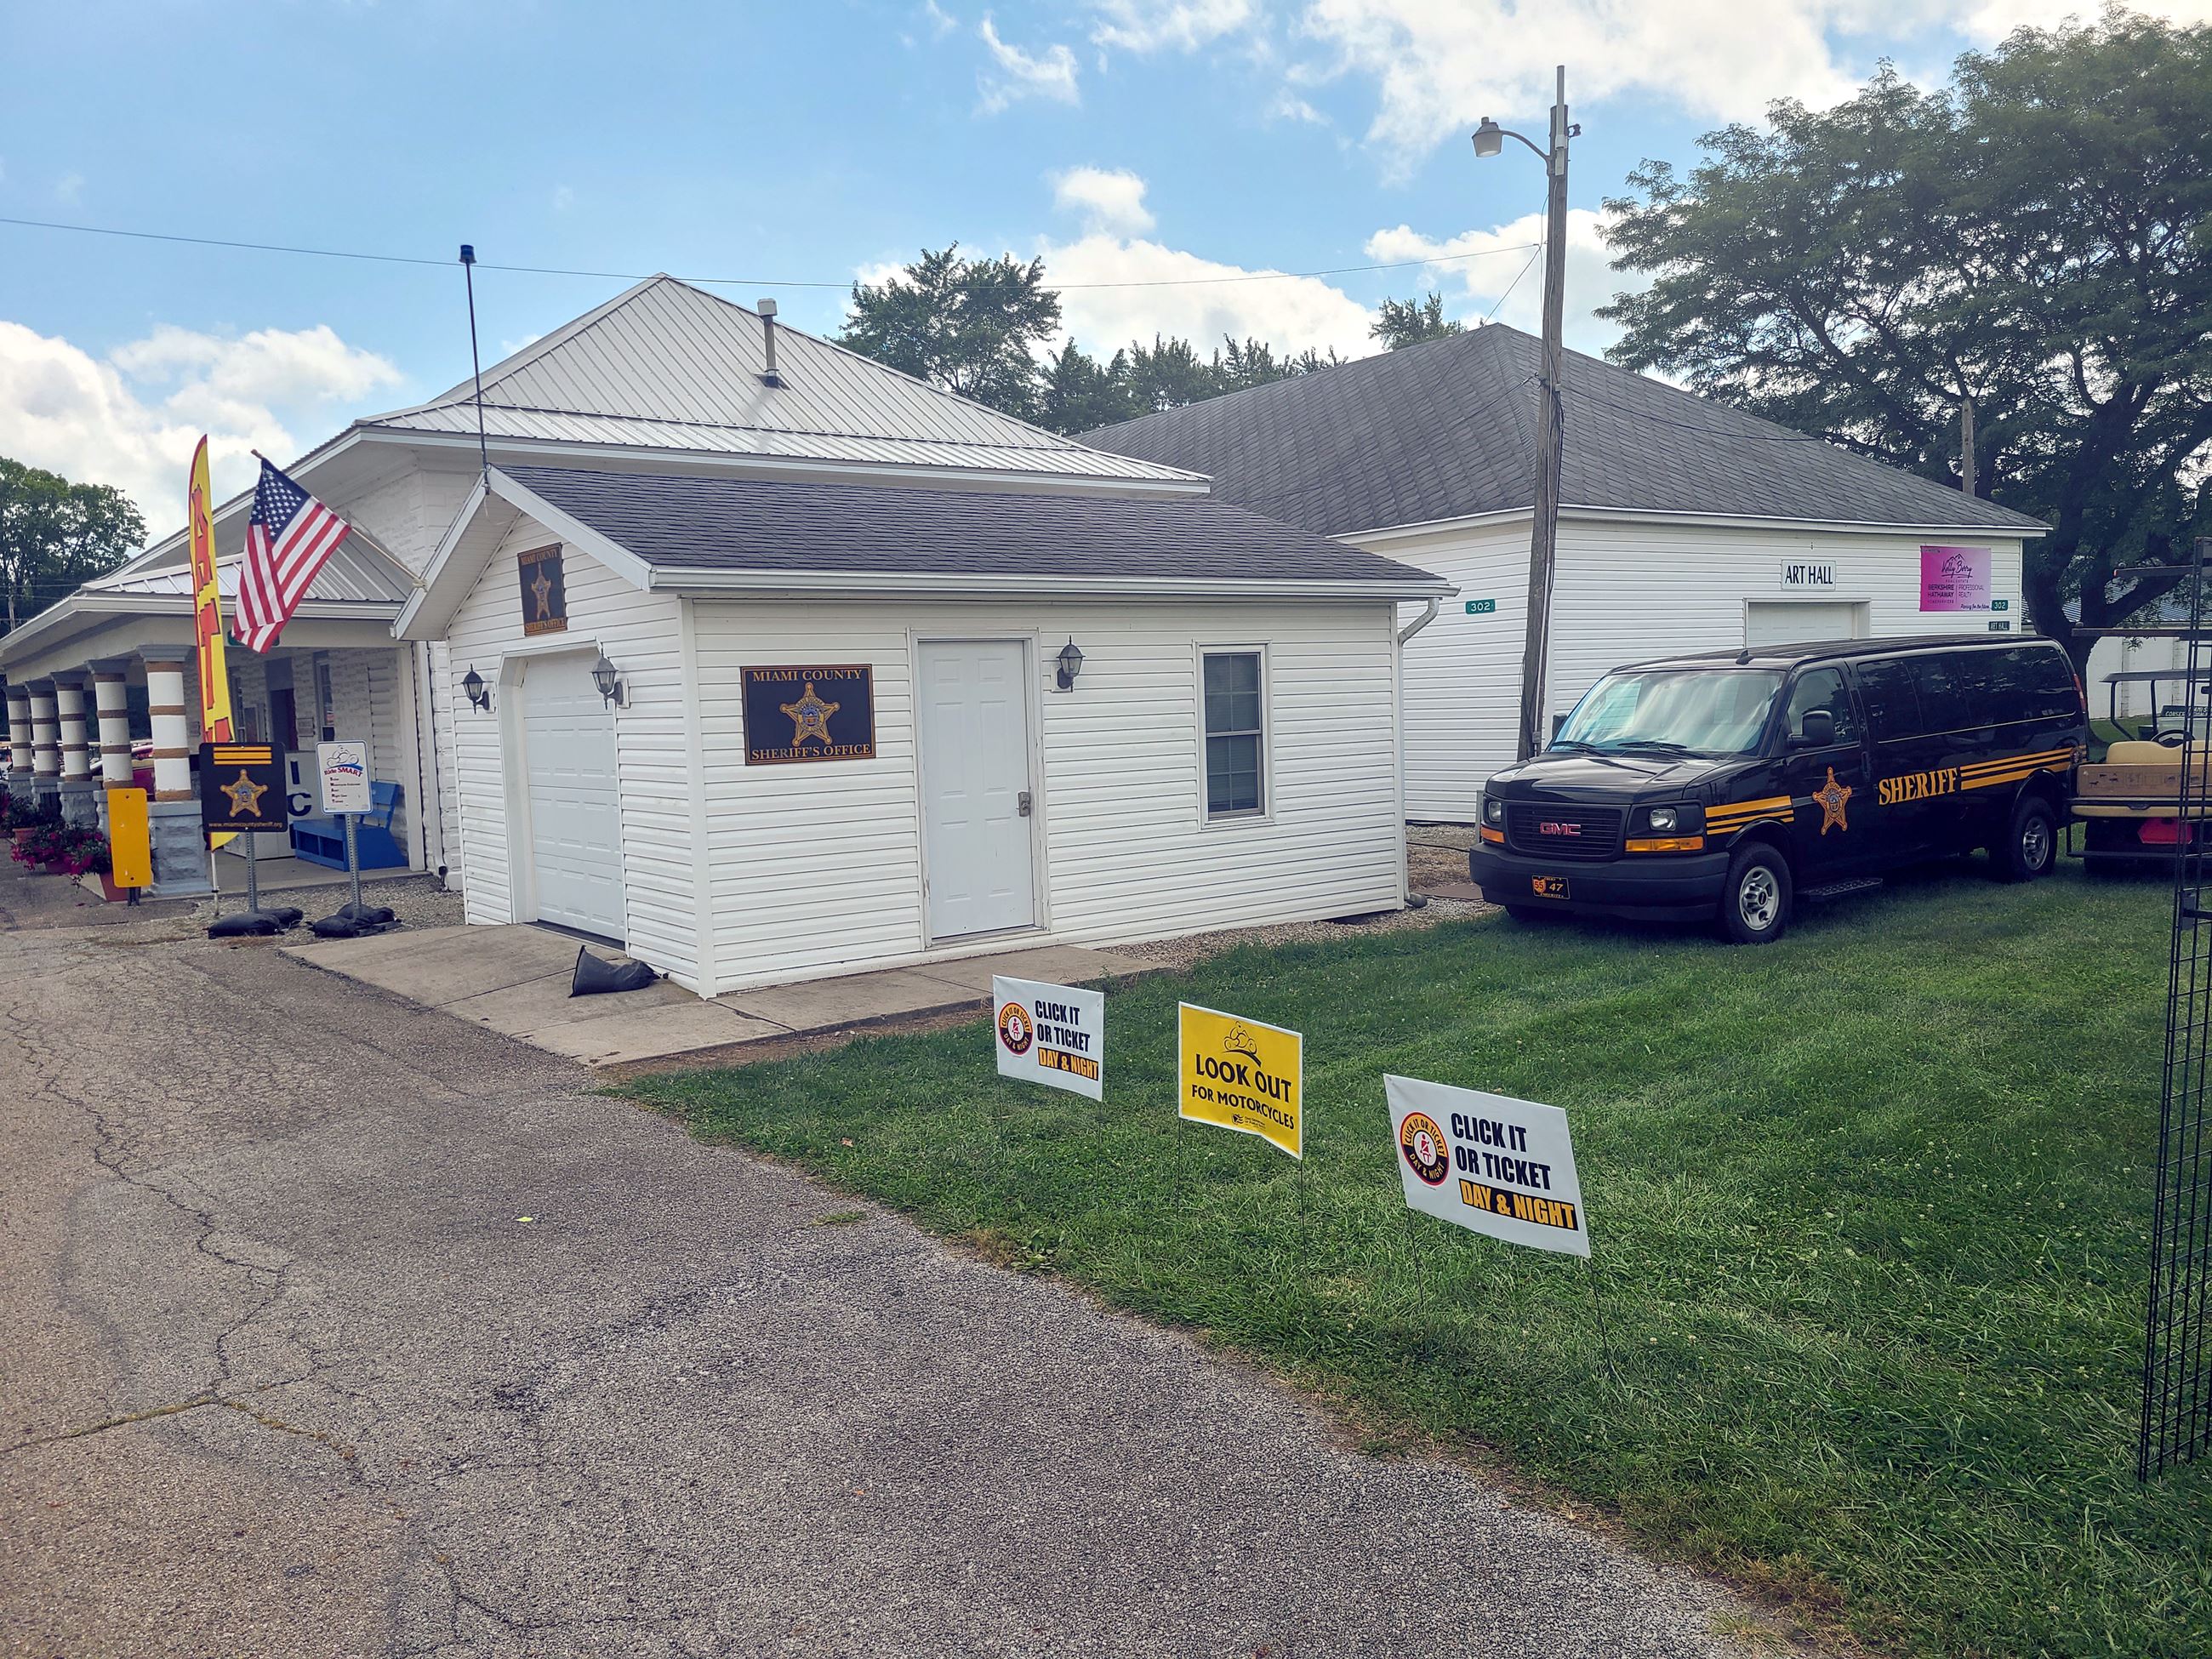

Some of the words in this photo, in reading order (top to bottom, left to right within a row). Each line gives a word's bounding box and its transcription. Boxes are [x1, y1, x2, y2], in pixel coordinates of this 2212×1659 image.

[537, 549, 557, 562] COUNTY
[1785, 565, 1805, 584] ART
[1808, 566, 1833, 584] HALL
[1470, 601, 1491, 612] 302
[1994, 601, 2006, 610] 302
[753, 671, 797, 681] MIAMI
[802, 670, 863, 681] COUNTY
[751, 746, 820, 761] SHERIFF'S
[824, 744, 871, 756] OFFICE
[338, 767, 363, 778] SMART
[1878, 767, 1958, 806] SHERIFF
[1540, 822, 1581, 836] GMC
[1534, 881, 1543, 889] 55
[1549, 883, 1564, 892] 47
[1021, 1012, 1030, 1032] TICKET
[1035, 1000, 1068, 1023] CLICK
[1069, 1006, 1080, 1026] IT
[1004, 1033, 1012, 1046] DAY
[1036, 1023, 1052, 1043] OR
[1053, 1026, 1090, 1052] TICKET
[1039, 1048, 1059, 1069] DAY
[1061, 1056, 1069, 1072] &
[1071, 1055, 1098, 1080] NIGHT
[1195, 1053, 1251, 1087] LOOK
[1255, 1070, 1292, 1103] OUT
[1191, 1084, 1214, 1103] FOR
[1217, 1091, 1295, 1130] MOTORCYCLES
[1405, 1120, 1416, 1143] CLICK
[1413, 1118, 1420, 1129] IT
[1420, 1119, 1429, 1131] OR
[1429, 1126, 1445, 1155] TICKET
[1451, 1113, 1507, 1149] CLICK
[1508, 1125, 1527, 1152] IT
[1410, 1153, 1422, 1171] DAY
[1429, 1161, 1445, 1179] NIGHT
[1455, 1145, 1480, 1175] OR
[1482, 1152, 1551, 1190] TICKET
[1460, 1180, 1491, 1211] DAY
[1497, 1194, 1511, 1216] &
[1514, 1194, 1575, 1229] NIGHT
